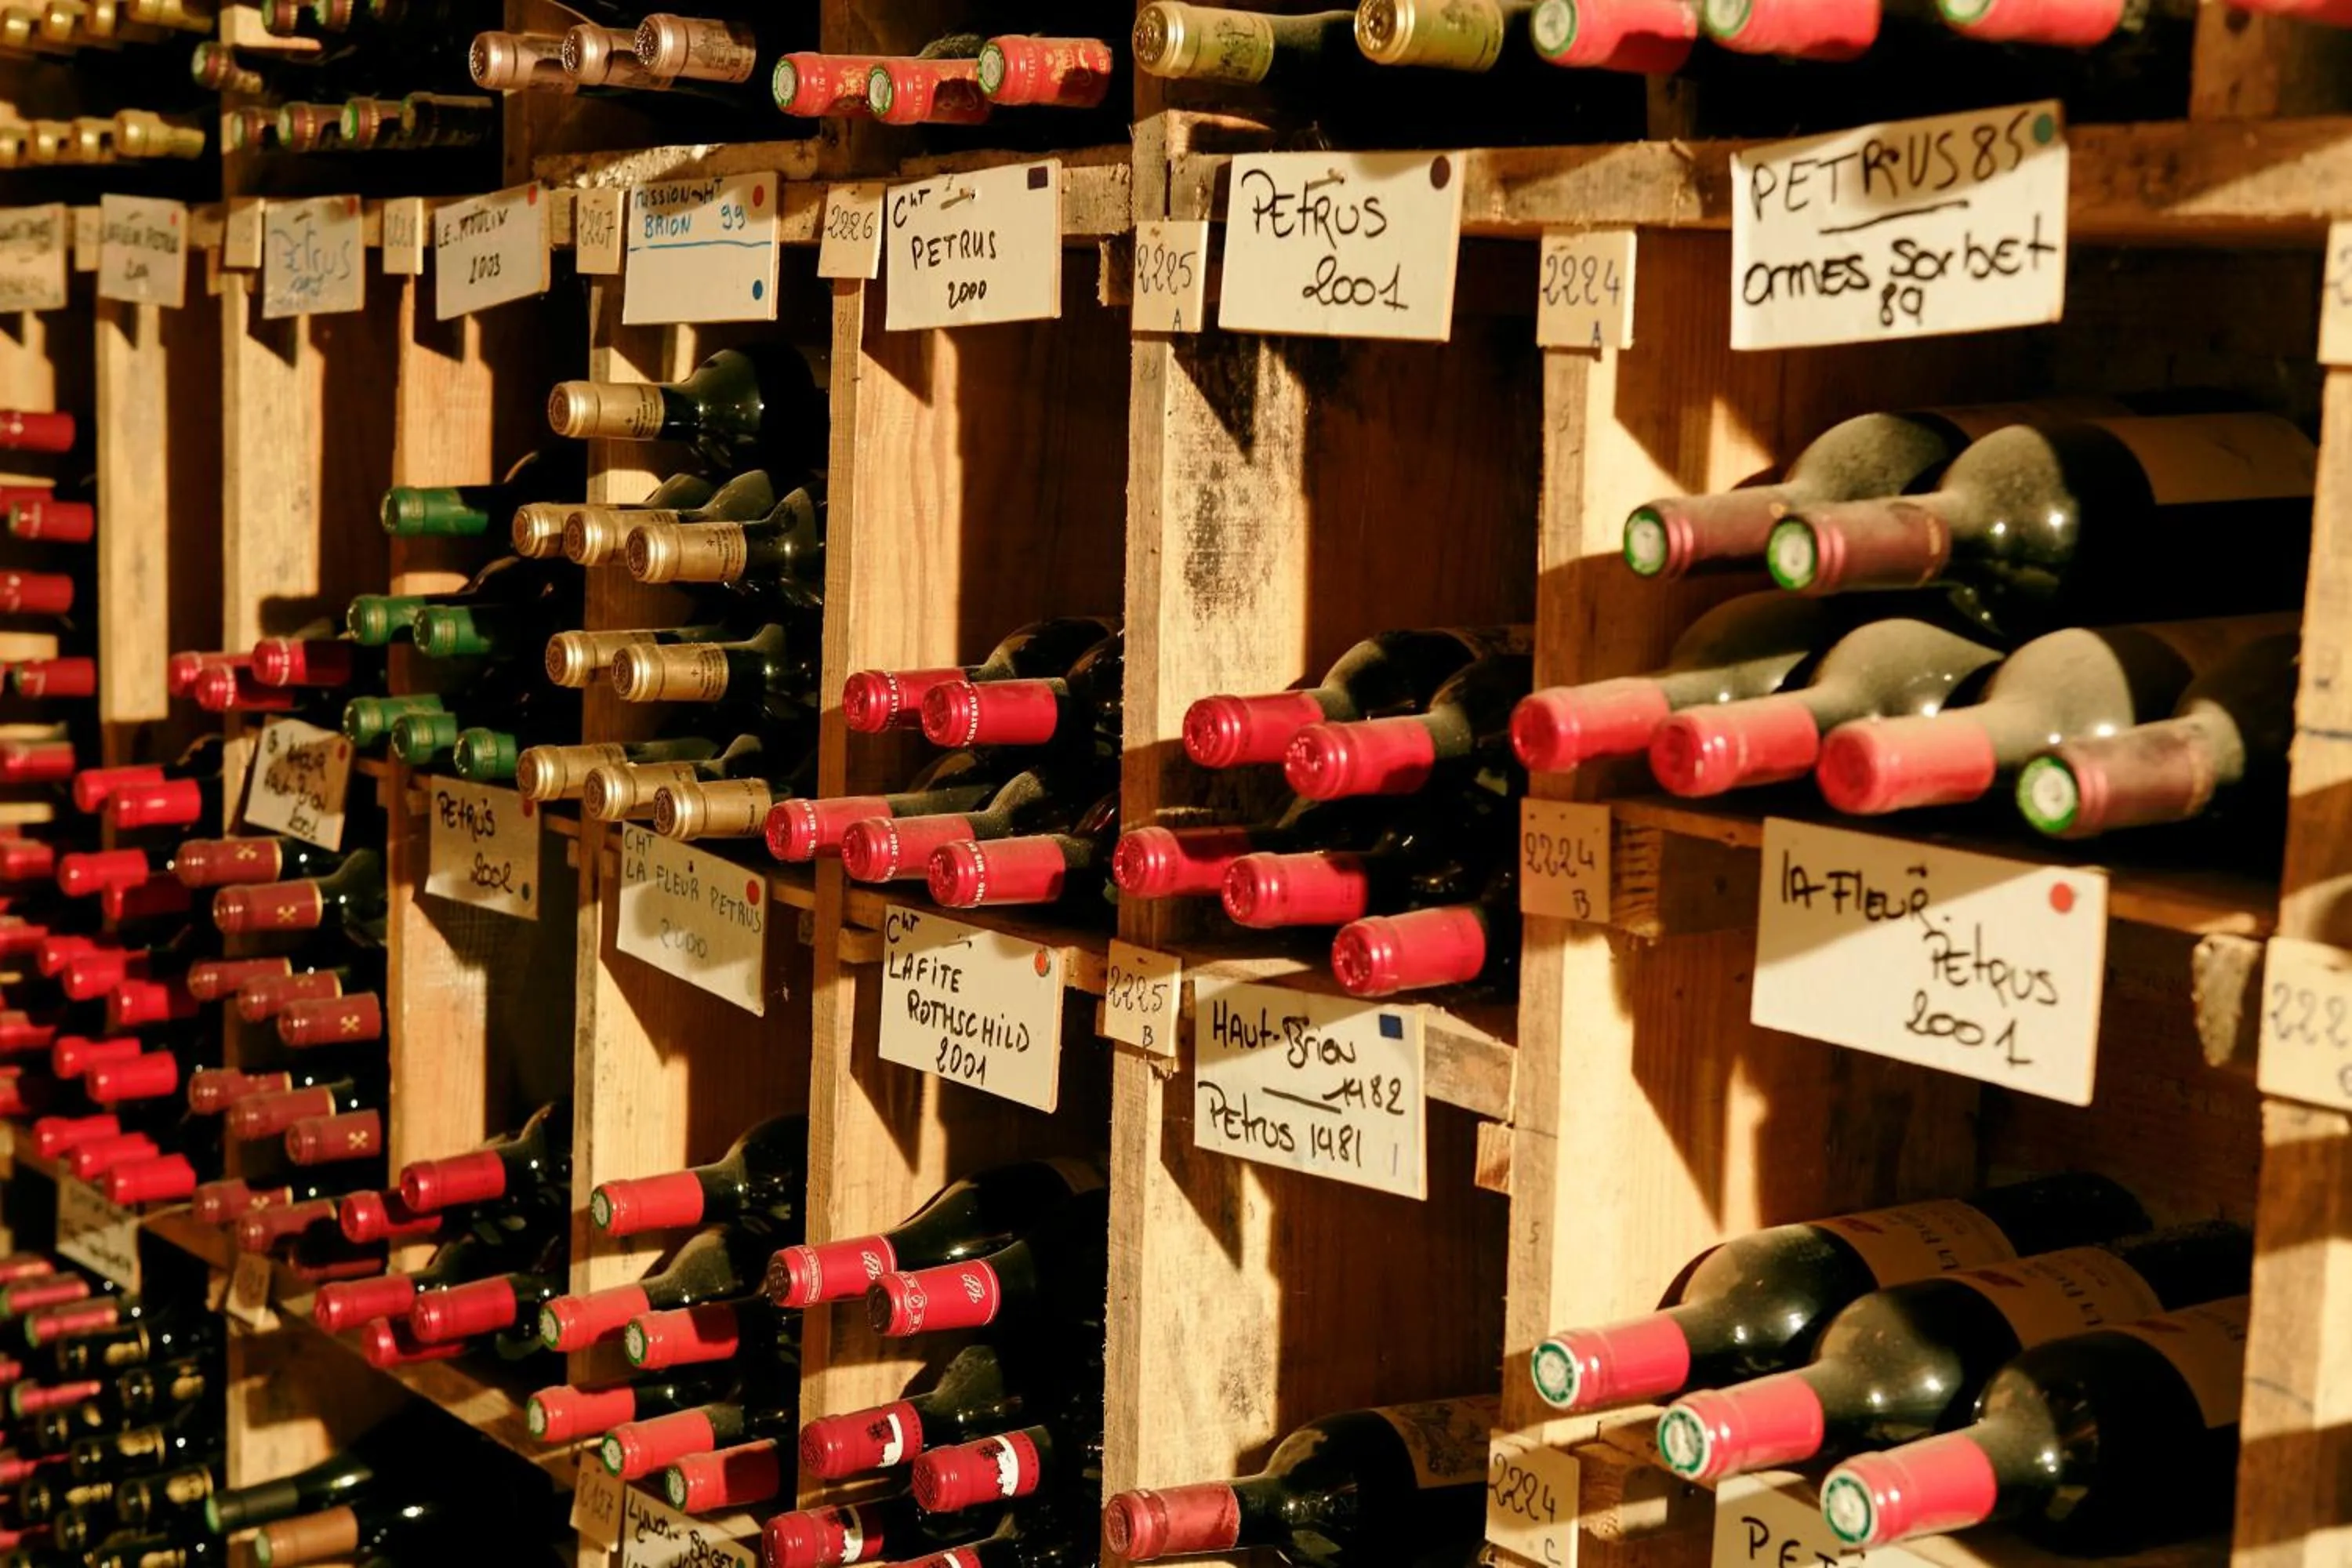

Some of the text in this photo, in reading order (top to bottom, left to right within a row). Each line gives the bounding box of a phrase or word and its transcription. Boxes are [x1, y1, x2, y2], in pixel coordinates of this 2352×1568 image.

[644, 212, 691, 238] BRION
[824, 204, 874, 241] 2226
[911, 229, 996, 270] PETRUS
[1137, 243, 1194, 296] 2225
[947, 280, 987, 310] 2000
[1302, 255, 1410, 311] 2001
[1541, 253, 1622, 307] 2224
[1524, 831, 1595, 877] 2224
[626, 858, 761, 933] LA FLEUR PETRUS
[1108, 965, 1168, 1014] 2225
[907, 994, 1031, 1054] ROTHSCHILD
[1142, 1025, 1154, 1048] B
[1905, 989, 2034, 1069] 2001
[935, 1037, 987, 1087] 2001
[1492, 1452, 1557, 1523] 2224
